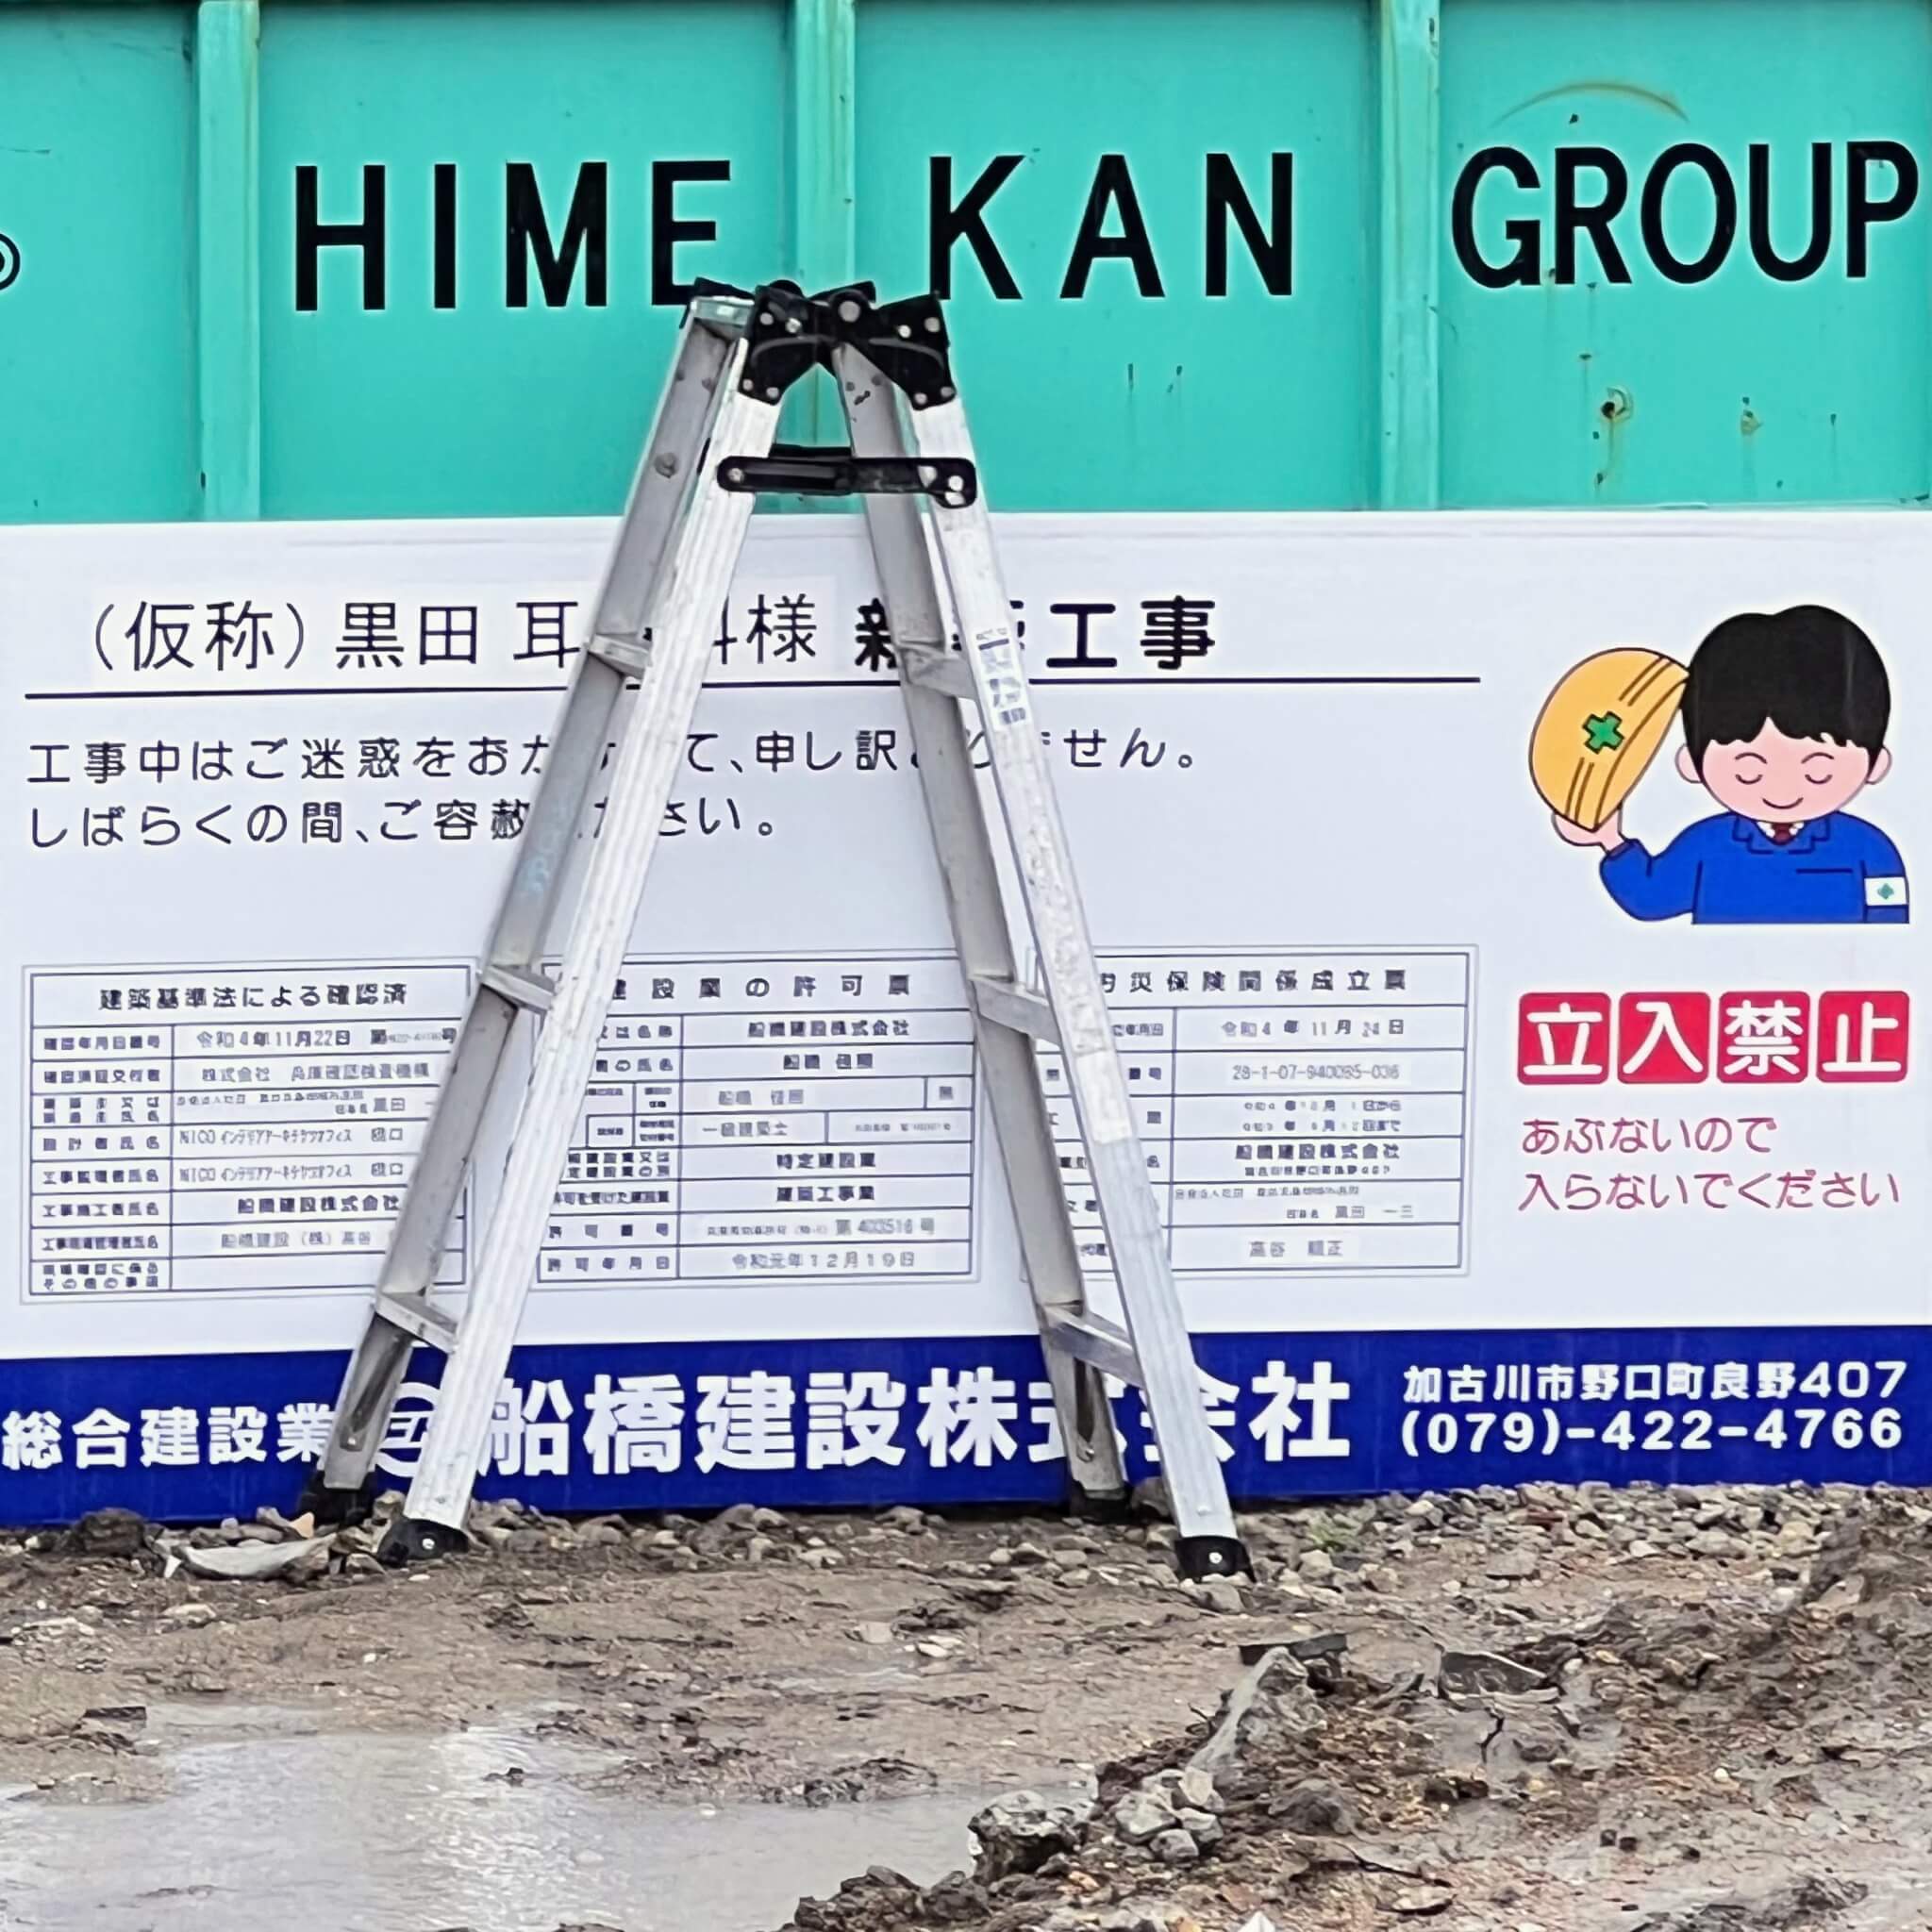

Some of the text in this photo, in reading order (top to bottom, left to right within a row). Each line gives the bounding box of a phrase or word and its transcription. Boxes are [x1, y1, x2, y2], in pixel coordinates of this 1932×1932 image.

[295, 141, 1919, 311] HIME KAN GROUP
[855, 595, 1216, 672] 新工事
[1523, 999, 1902, 1077] 立入禁止
[1521, 1116, 1778, 1156] あぶないので
[1517, 1169, 1900, 1212] 入らないでください
[1402, 1359, 1908, 1405] 加古川市野口町良野407
[2, 1406, 336, 1470] 総合建設業
[1400, 1408, 1905, 1457] (079)-422-4766
